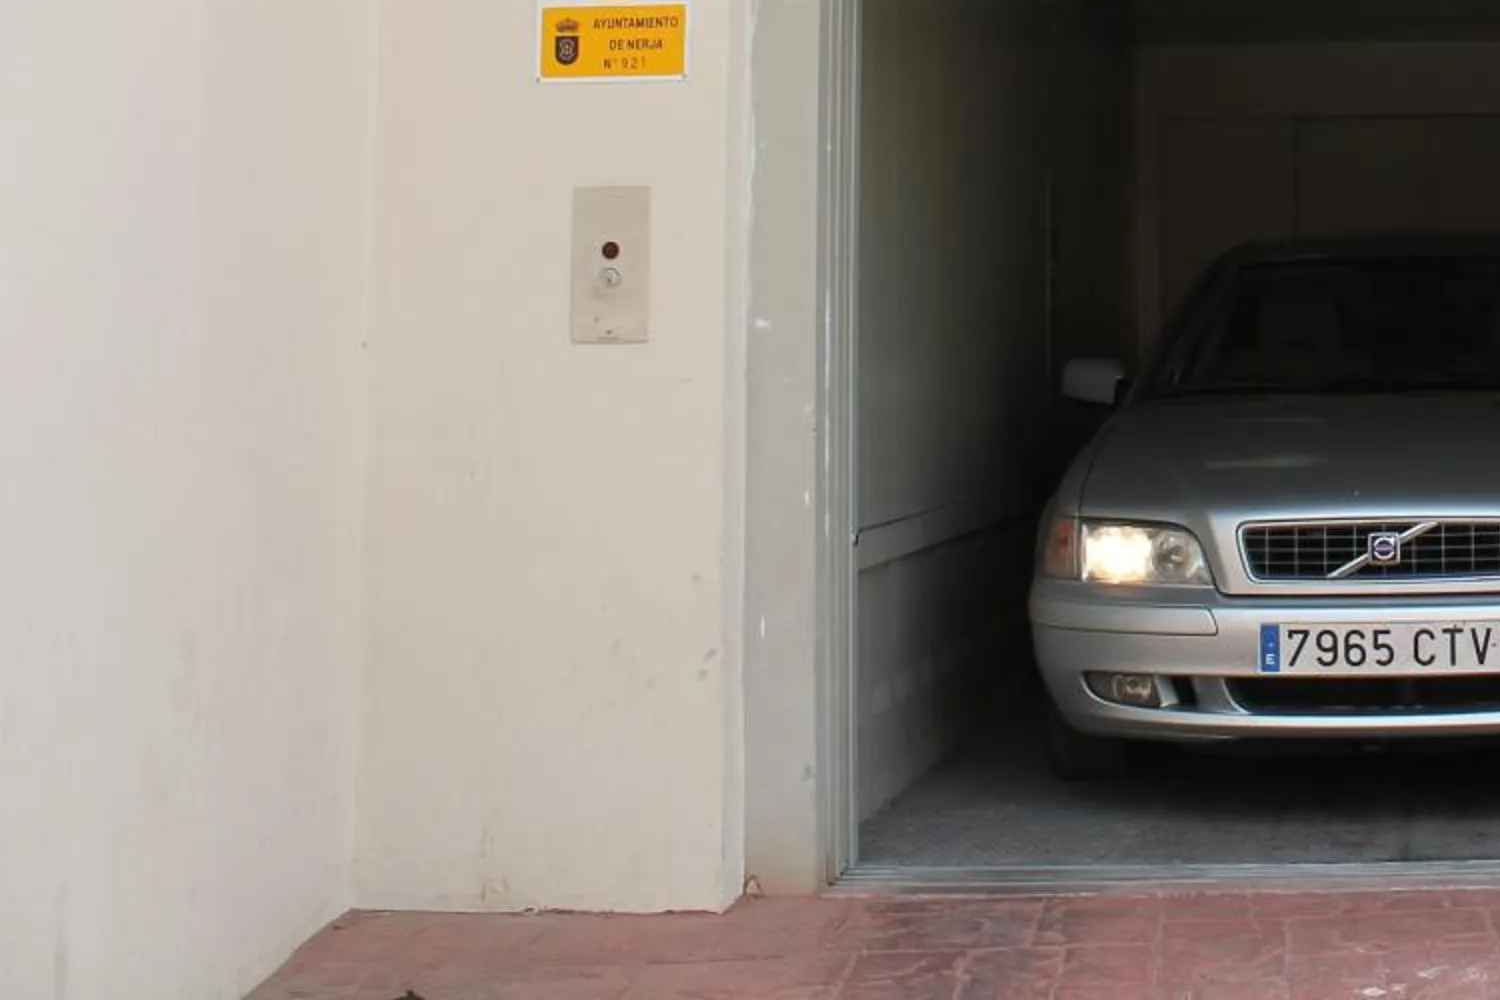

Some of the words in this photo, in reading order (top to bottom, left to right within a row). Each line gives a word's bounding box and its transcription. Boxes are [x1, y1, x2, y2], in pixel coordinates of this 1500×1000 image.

[593, 16, 679, 29] AYUNTAMIENTO
[609, 39, 624, 50] DE
[627, 39, 663, 50] NERJA
[1287, 629, 1395, 667] 7965
[1413, 627, 1492, 666] CTV
